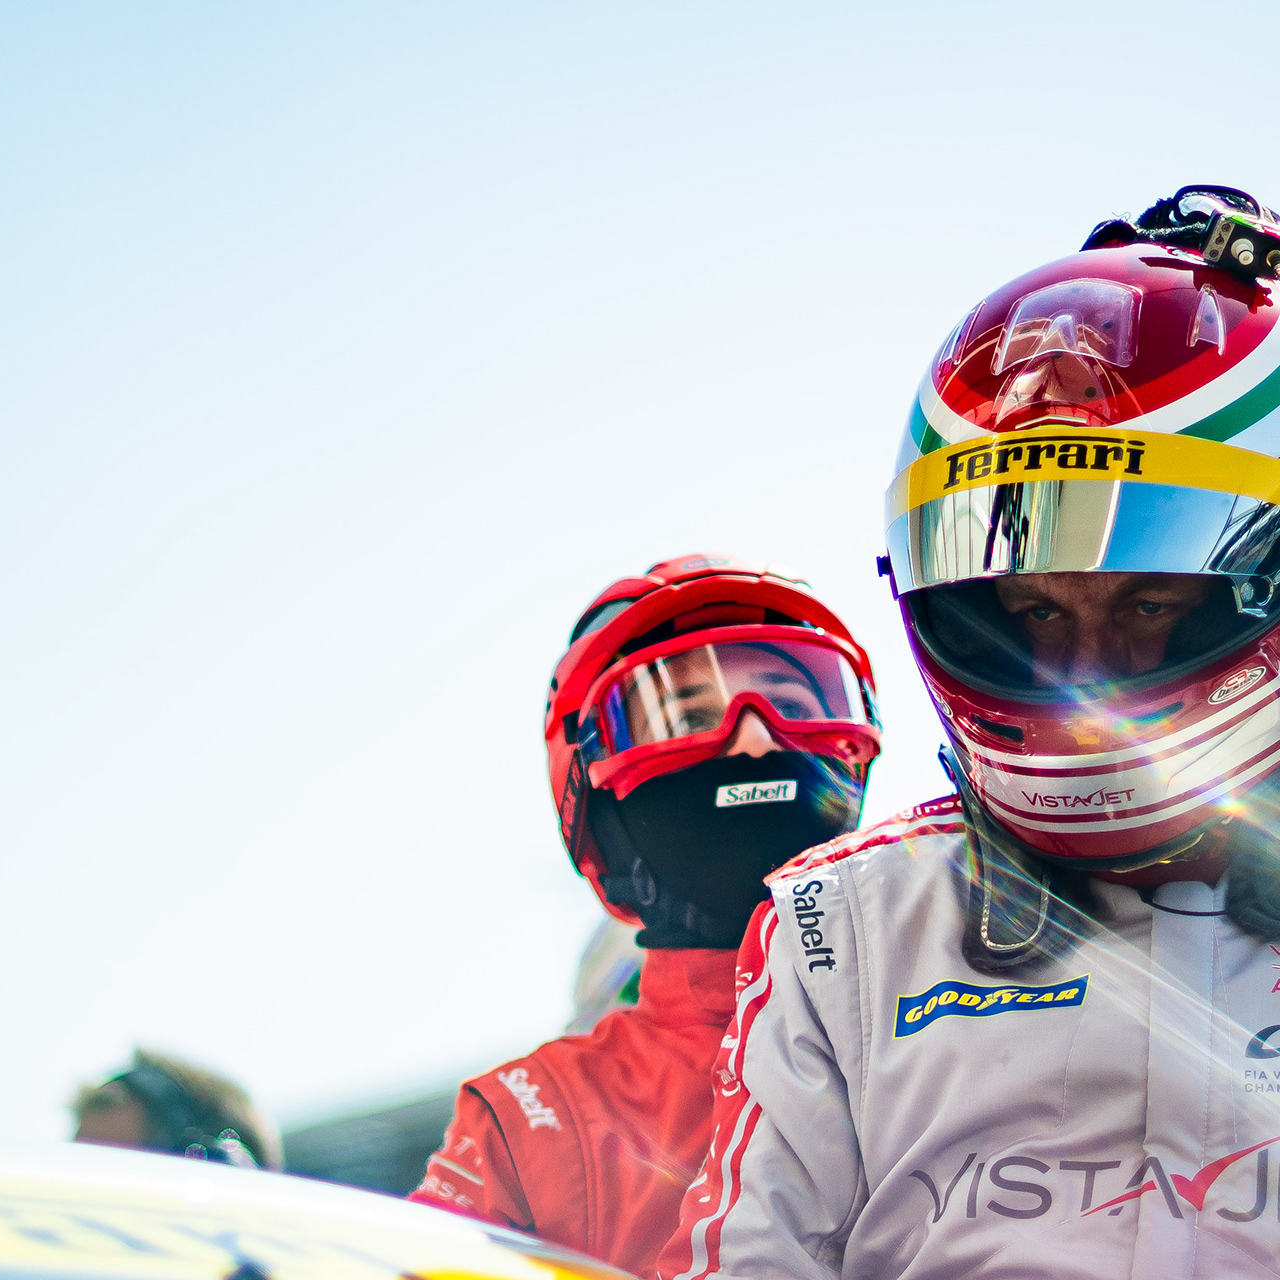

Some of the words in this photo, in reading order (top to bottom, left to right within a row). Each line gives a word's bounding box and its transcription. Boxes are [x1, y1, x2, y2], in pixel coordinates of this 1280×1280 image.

[943, 435, 1147, 491] Ferrari
[725, 783, 789, 804] Sabelt
[1020, 786, 1136, 808] VISTAJET
[792, 880, 837, 974] Sabelt
[904, 987, 1080, 1024] GOODYEAR
[1243, 1069, 1268, 1081] FIA
